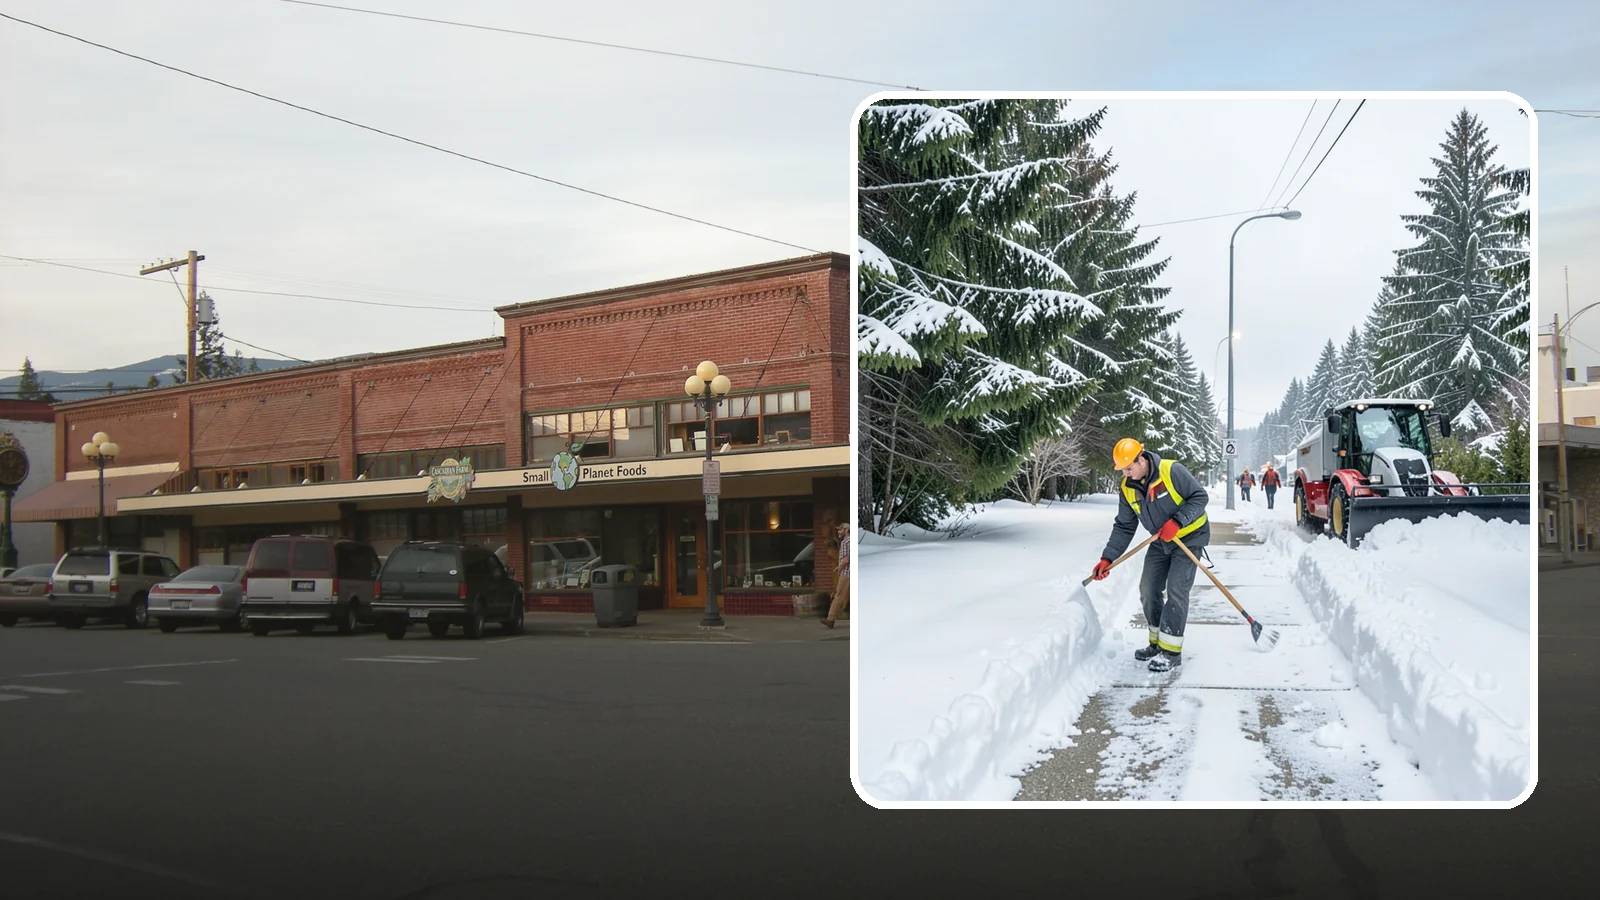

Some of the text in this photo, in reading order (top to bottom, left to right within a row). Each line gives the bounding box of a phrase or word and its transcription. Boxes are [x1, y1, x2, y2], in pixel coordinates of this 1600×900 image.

[523, 464, 647, 483] Small Planet Foods
